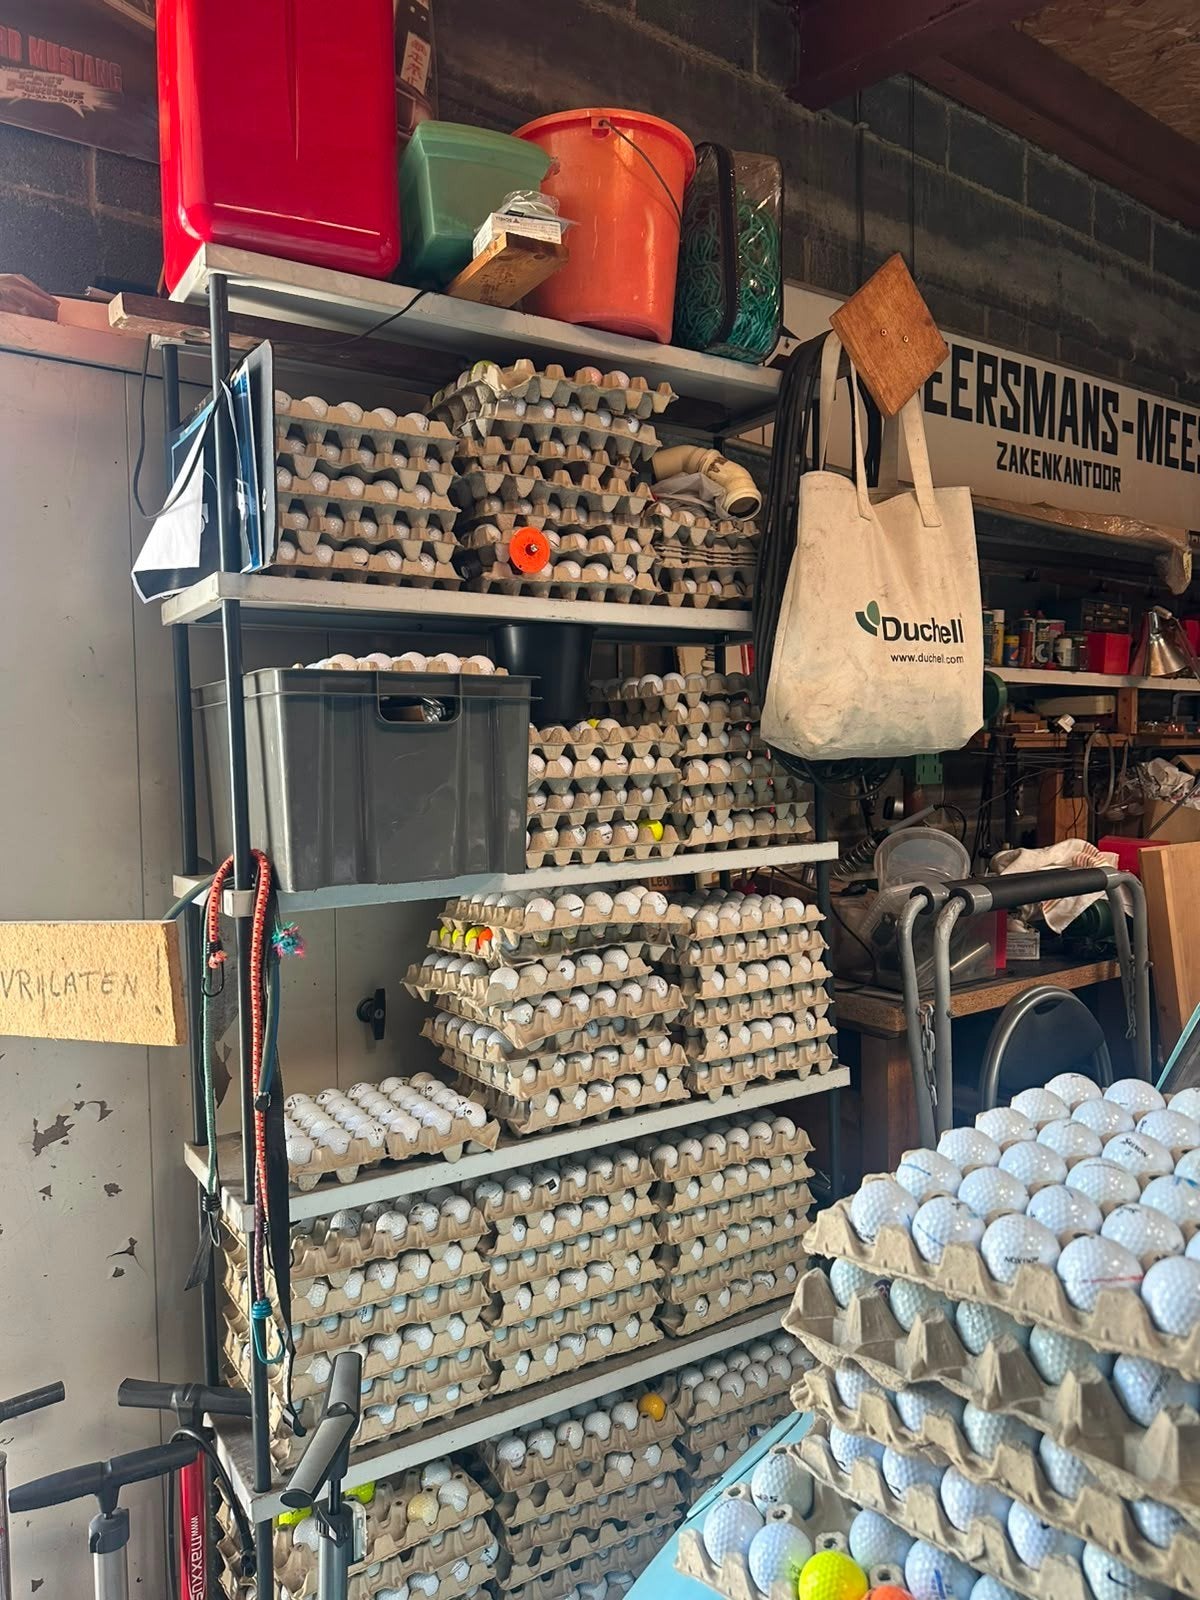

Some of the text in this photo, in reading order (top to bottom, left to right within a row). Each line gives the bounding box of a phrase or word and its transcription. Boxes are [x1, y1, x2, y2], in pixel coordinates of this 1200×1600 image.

[28, 35, 122, 93] MUSTANG
[996, 440, 1121, 493] ZAKENKANTOOR
[882, 615, 964, 644] Duchell
